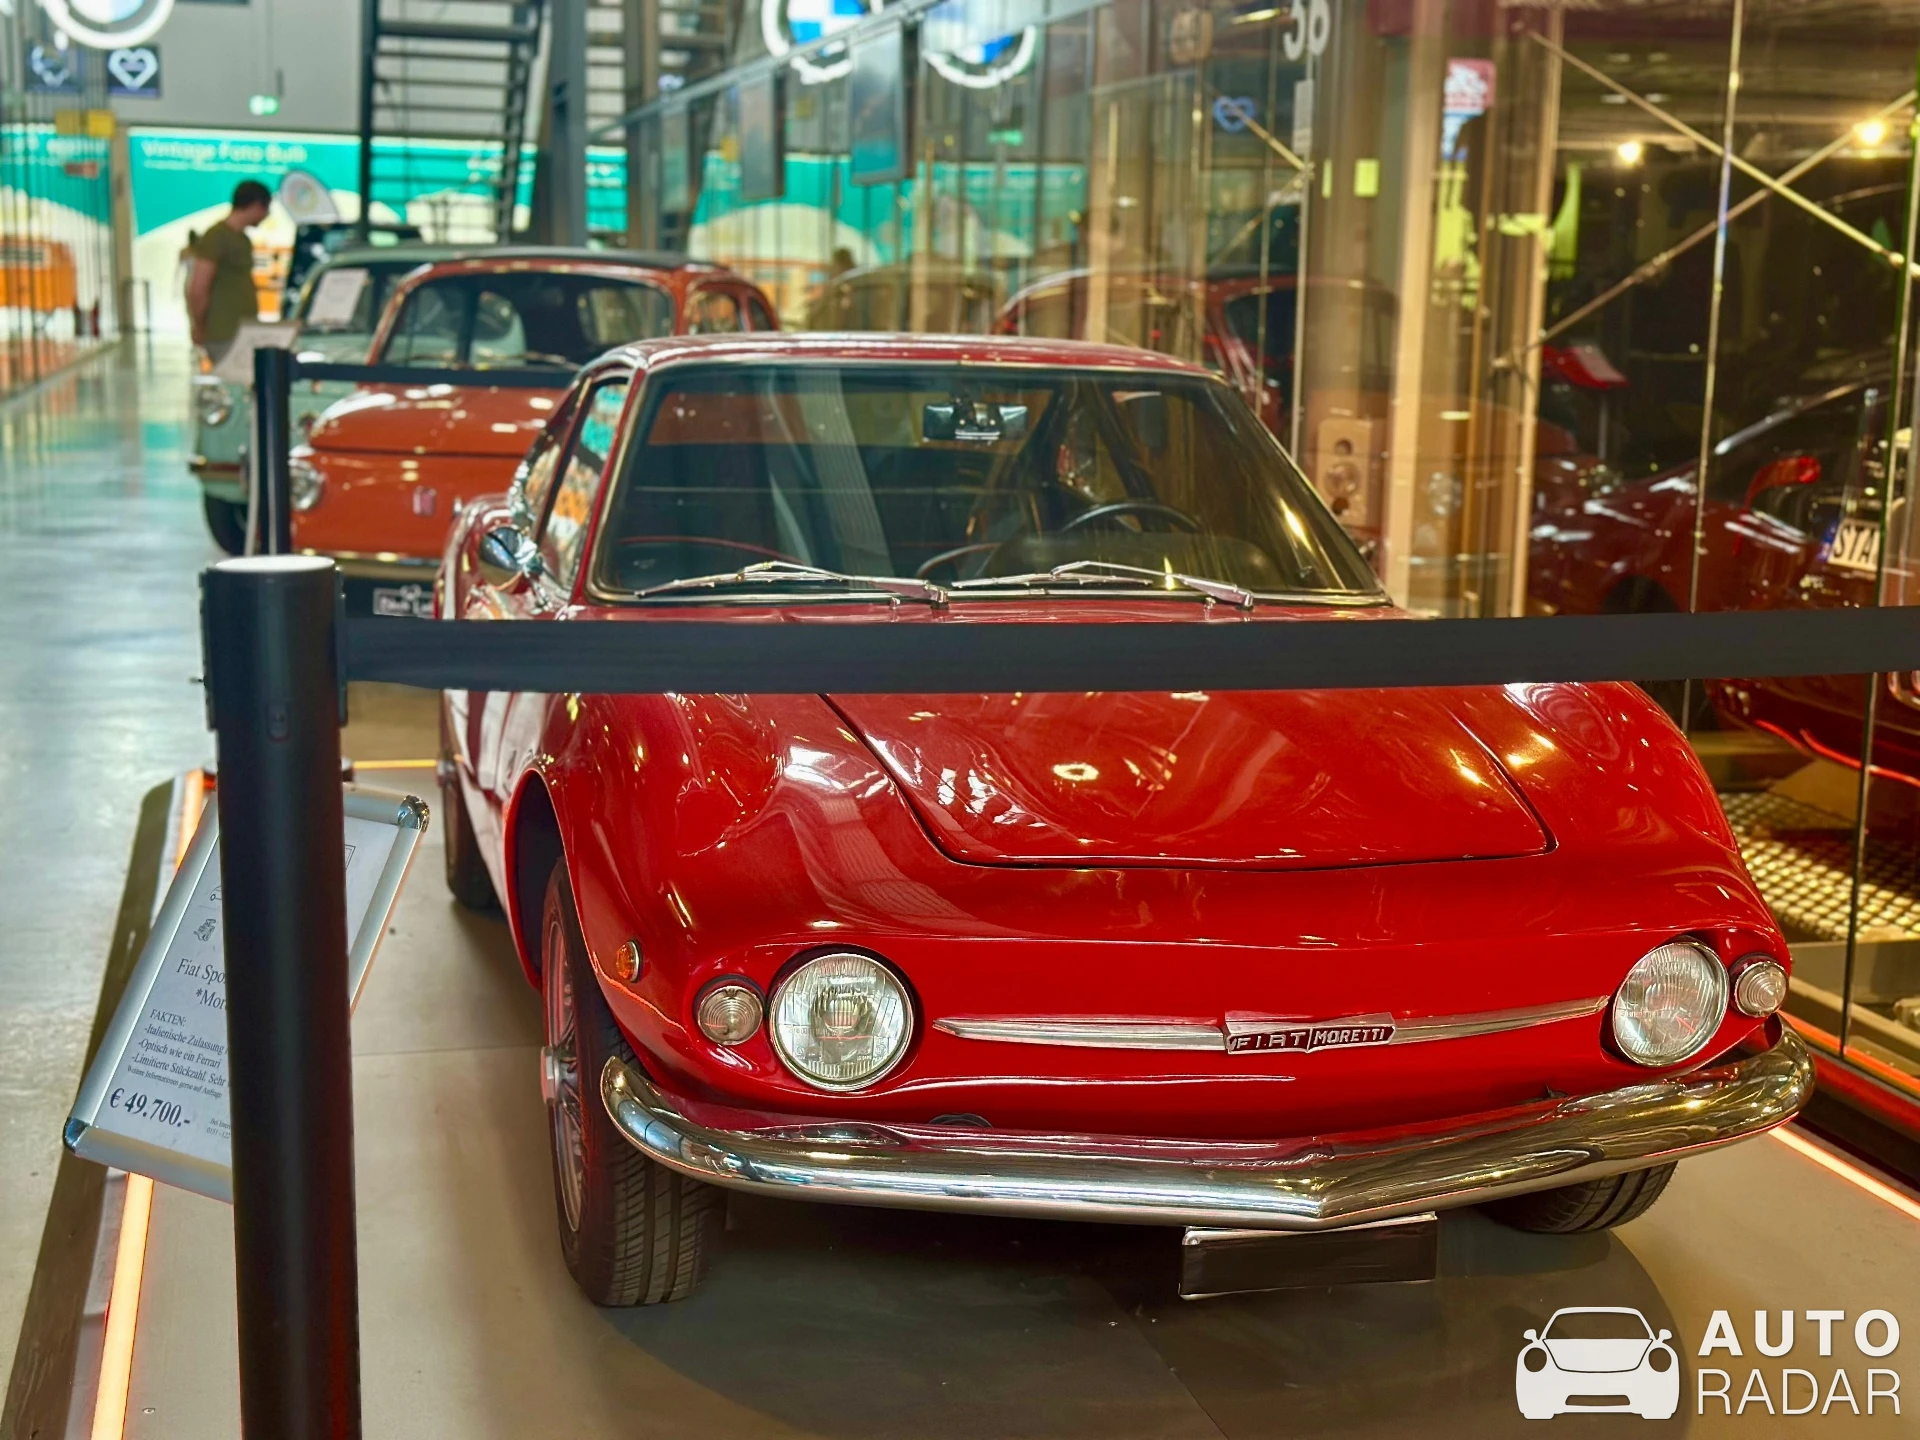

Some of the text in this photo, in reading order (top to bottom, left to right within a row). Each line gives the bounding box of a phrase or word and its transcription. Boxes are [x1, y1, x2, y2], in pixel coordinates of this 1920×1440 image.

[177, 958, 226, 985] Fiat Spo
[196, 988, 227, 1010] Mor
[149, 1009, 186, 1027] FAKTEN:
[144, 1024, 225, 1055] -Italienische Zulassung
[1236, 1028, 1386, 1049] FIAT MORETTI
[138, 1038, 222, 1068] -Optisch wie ein Ferrari
[132, 1052, 170, 1070] -Limitierte
[208, 1073, 226, 1087] Sehr
[110, 1087, 190, 1128] € 49.700.-
